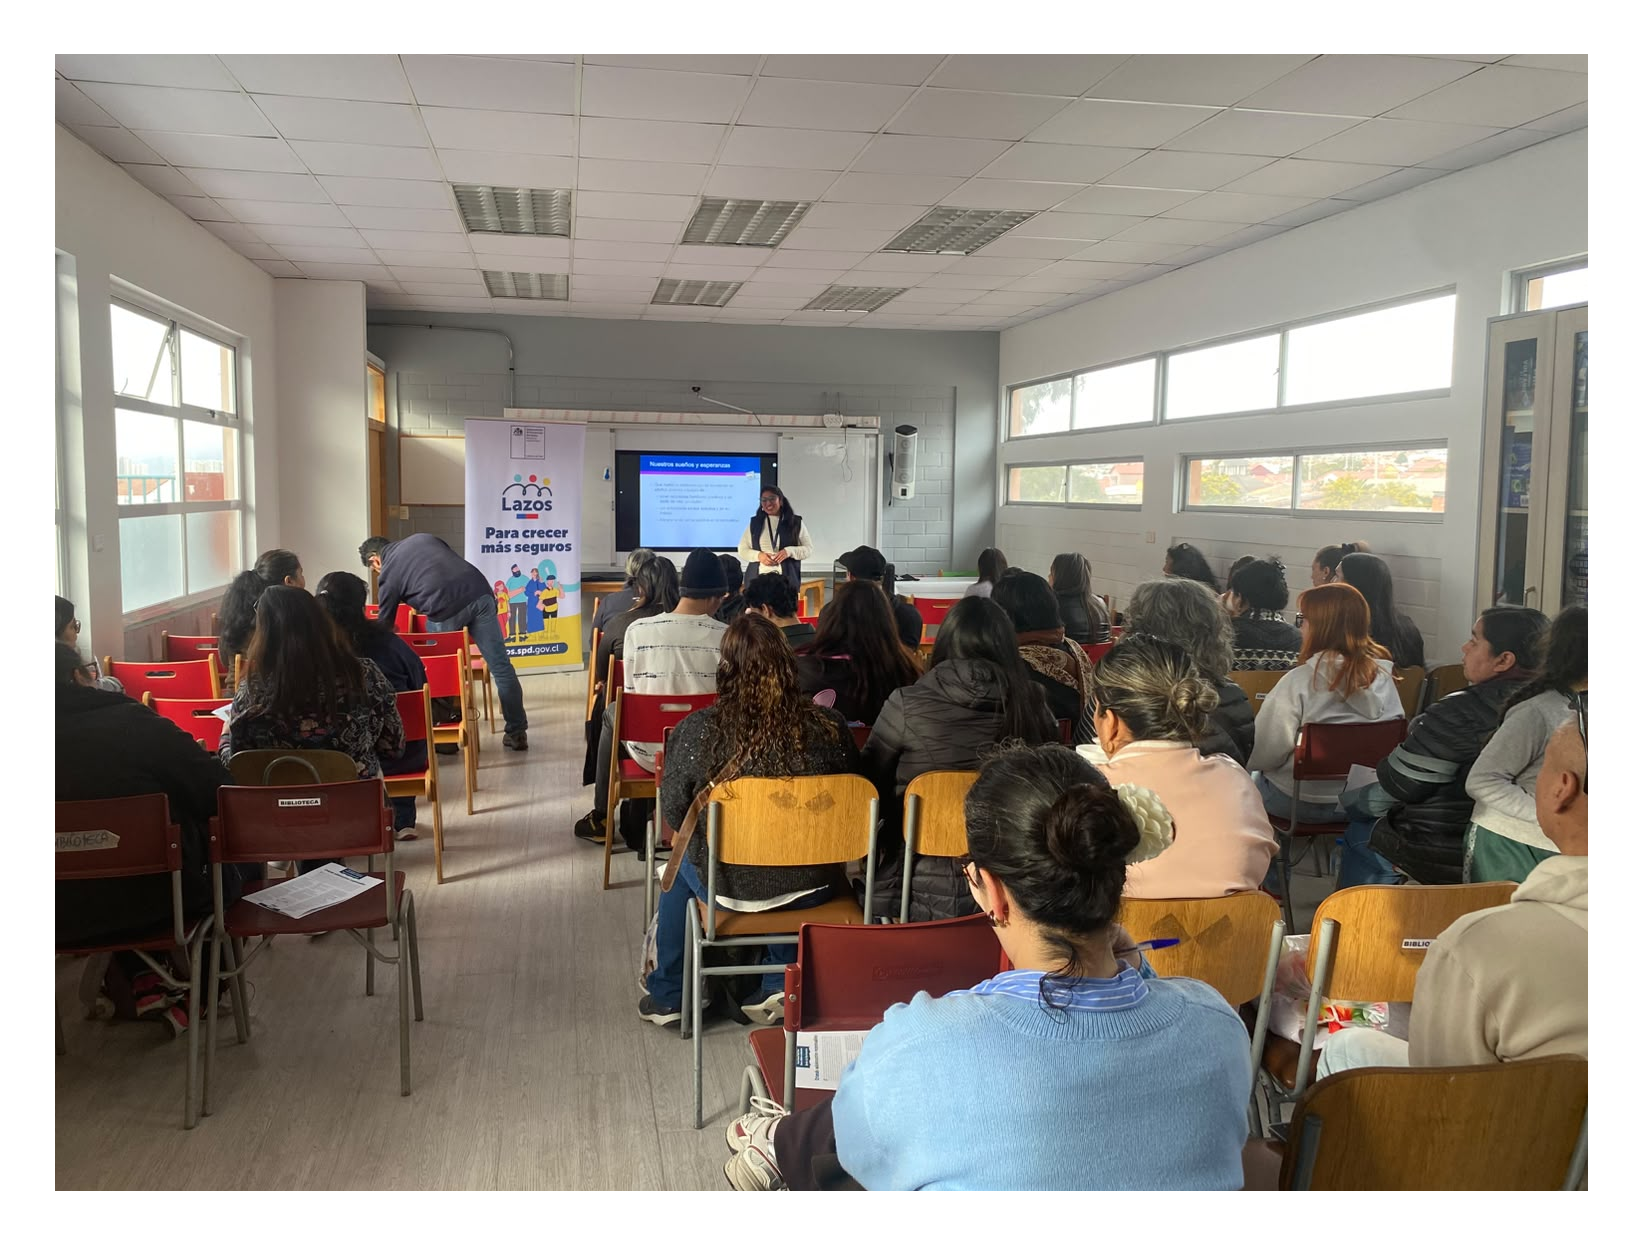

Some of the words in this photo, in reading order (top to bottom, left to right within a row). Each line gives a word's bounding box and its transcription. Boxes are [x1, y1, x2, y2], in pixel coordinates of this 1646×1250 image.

[502, 497, 553, 511] Lazos
[485, 527, 519, 539] Para
[522, 529, 568, 538] crecer
[481, 540, 511, 554] más
[514, 543, 572, 556] seguros
